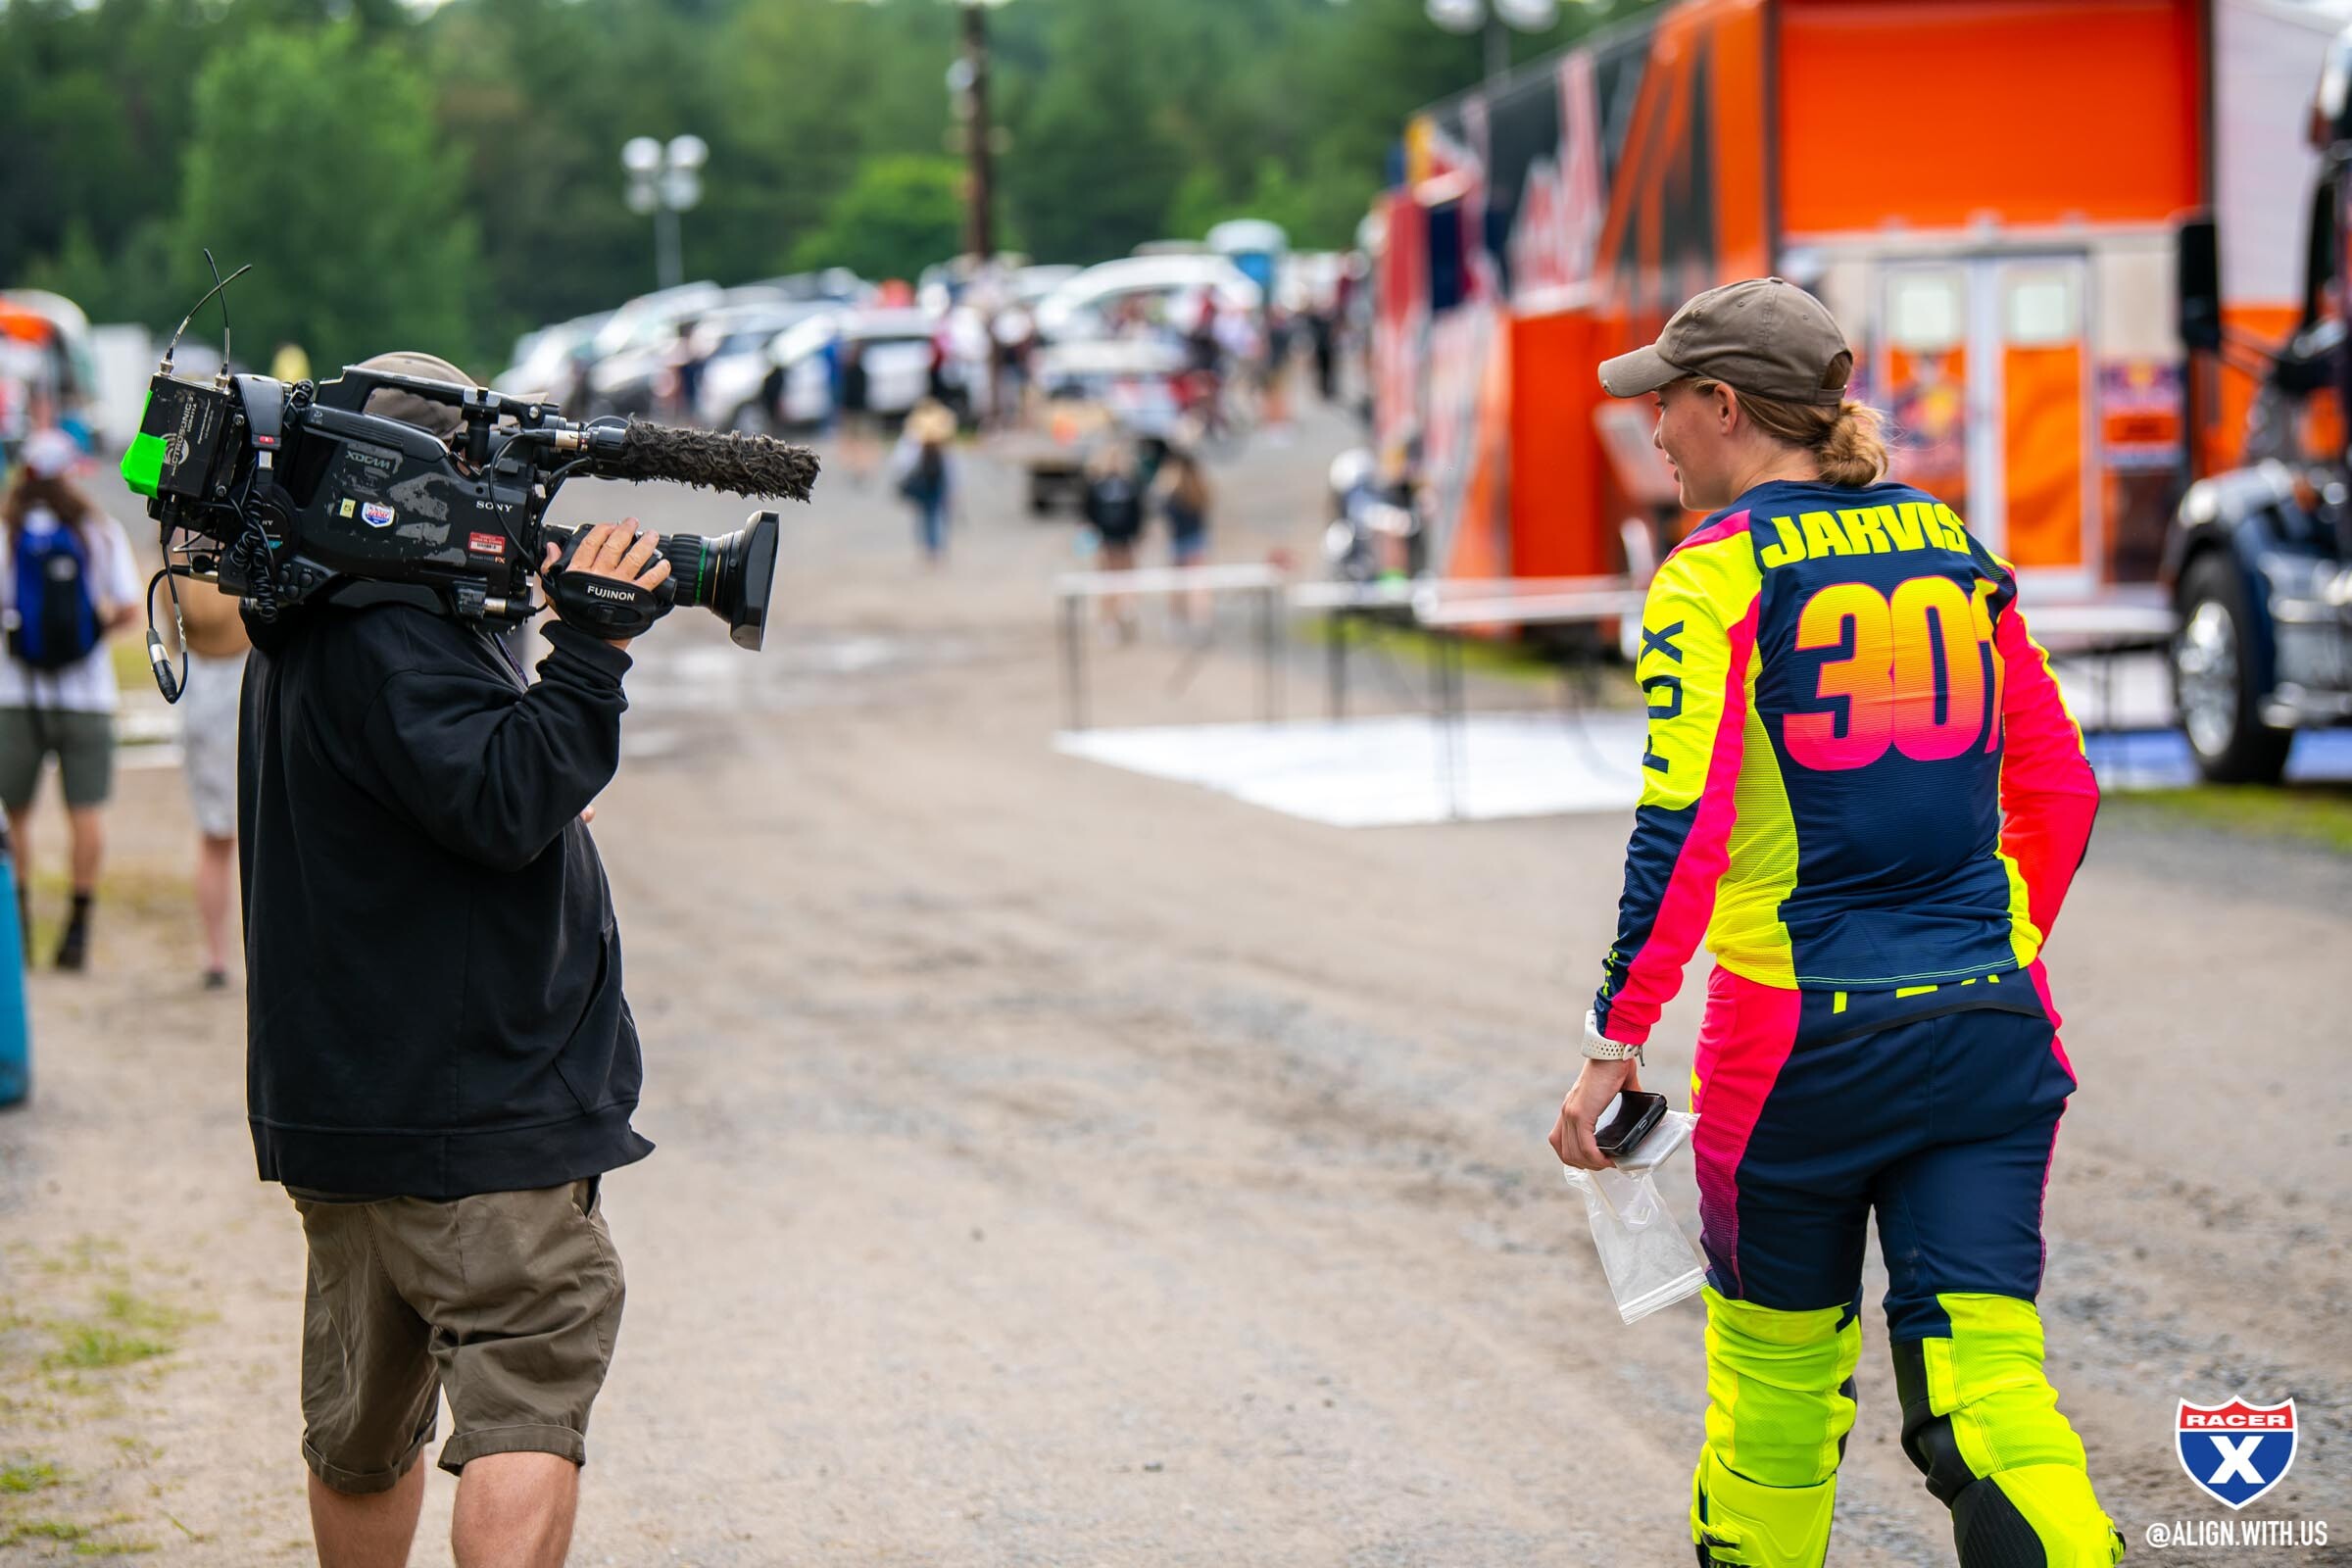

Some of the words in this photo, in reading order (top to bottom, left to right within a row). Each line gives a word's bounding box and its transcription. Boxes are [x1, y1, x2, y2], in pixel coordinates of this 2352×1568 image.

[172, 392, 194, 476] CTROSONICS
[345, 451, 391, 469] XDCAM
[1760, 502, 1972, 569] JARVIS
[587, 585, 635, 602] FUJINON
